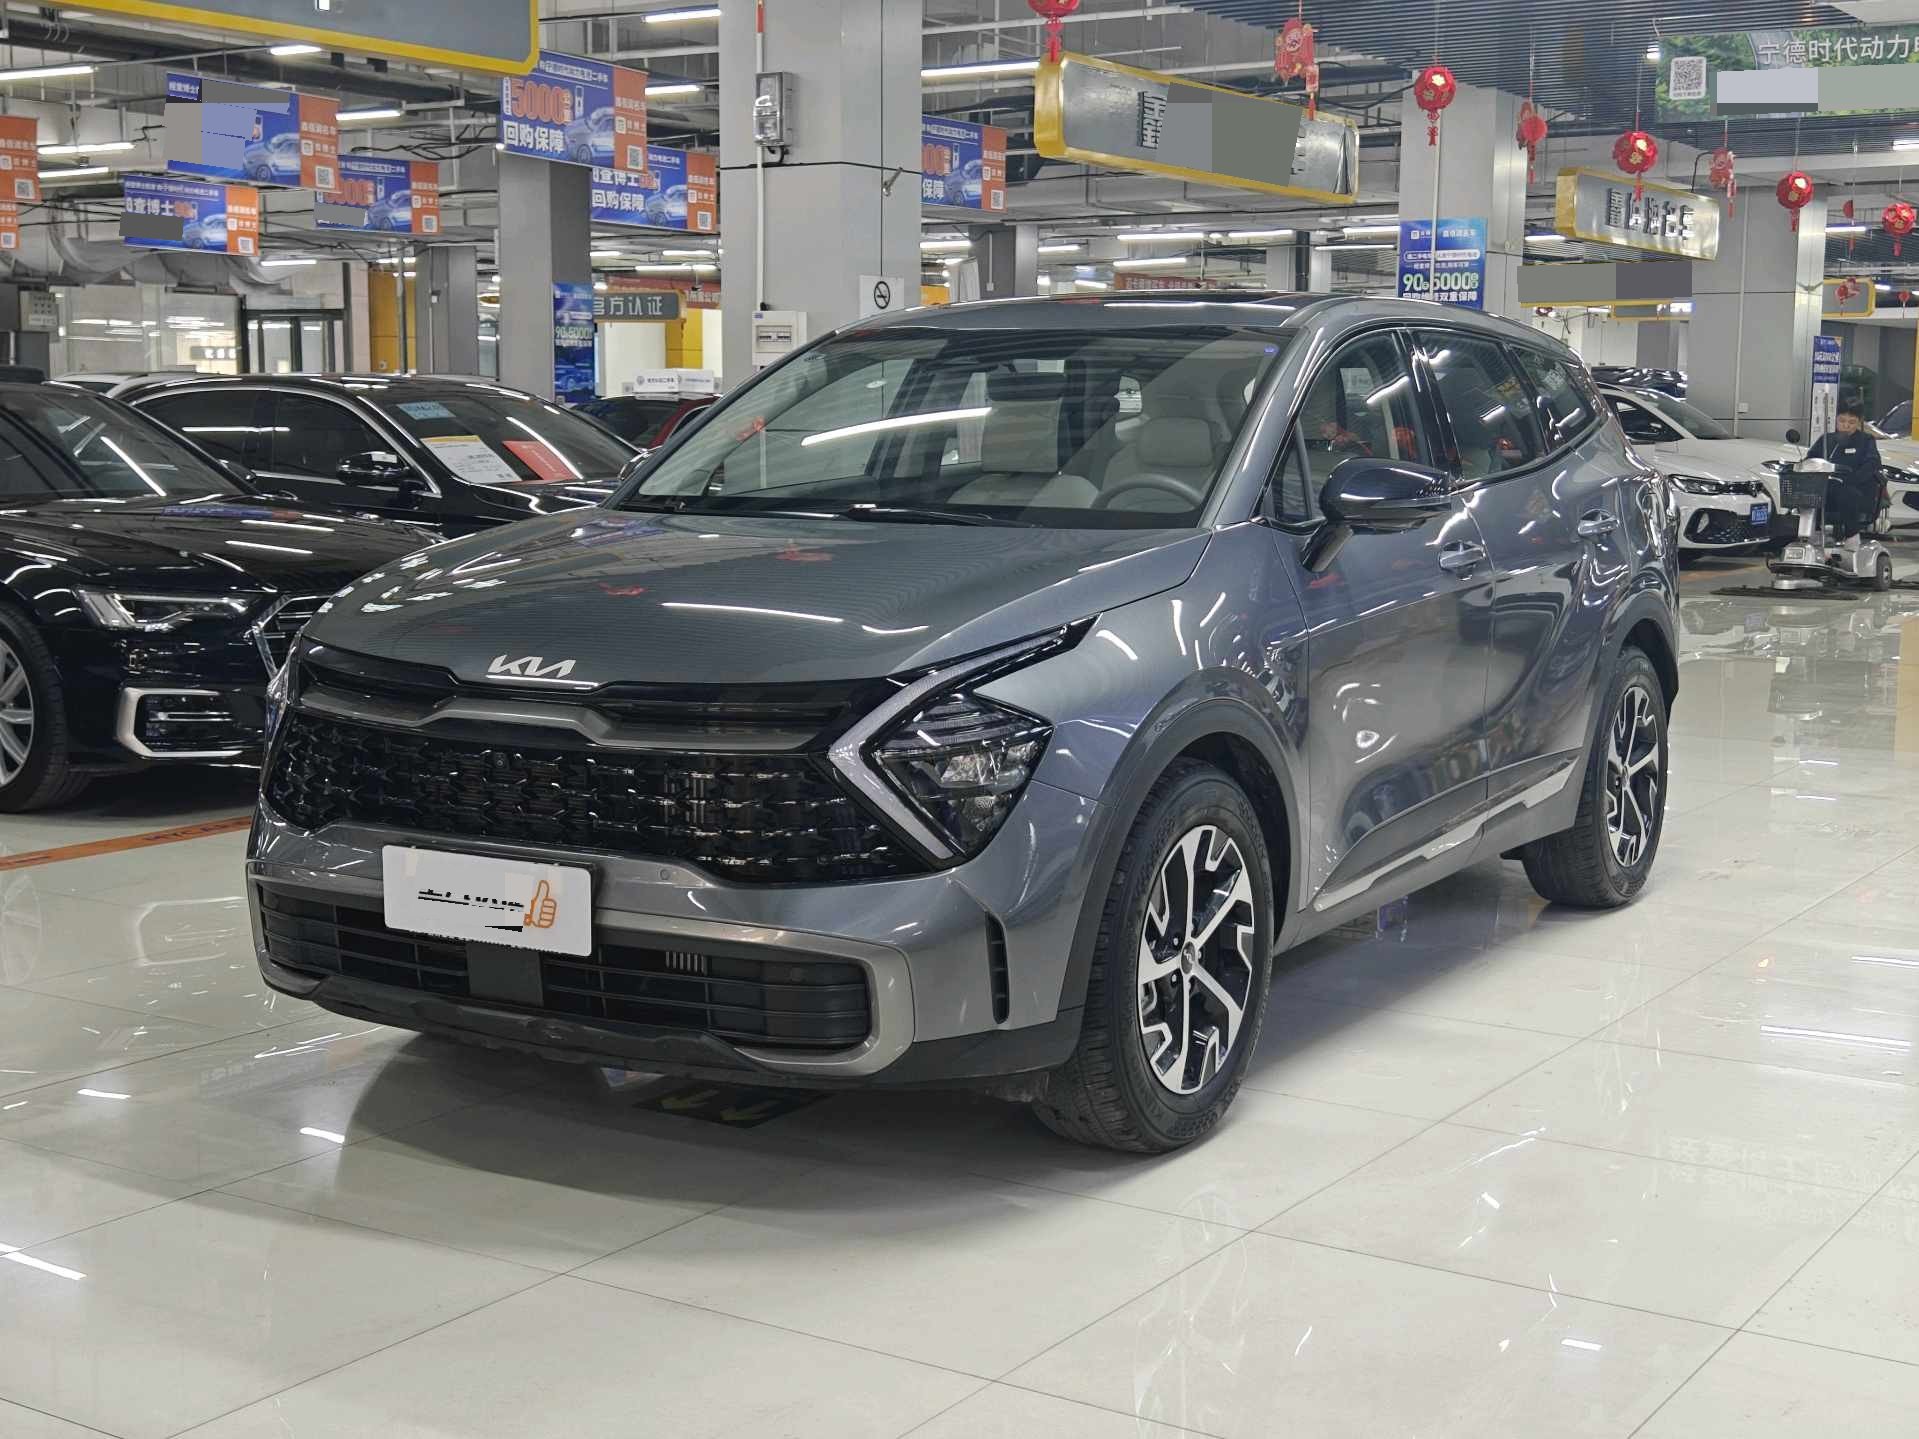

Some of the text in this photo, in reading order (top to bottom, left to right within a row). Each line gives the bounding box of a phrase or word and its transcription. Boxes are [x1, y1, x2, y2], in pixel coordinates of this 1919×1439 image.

[1757, 34, 1919, 66] 宁德时代动力
[503, 120, 565, 154] 回购保障
[592, 189, 645, 212] 回购保障
[487, 654, 577, 679] KIA
